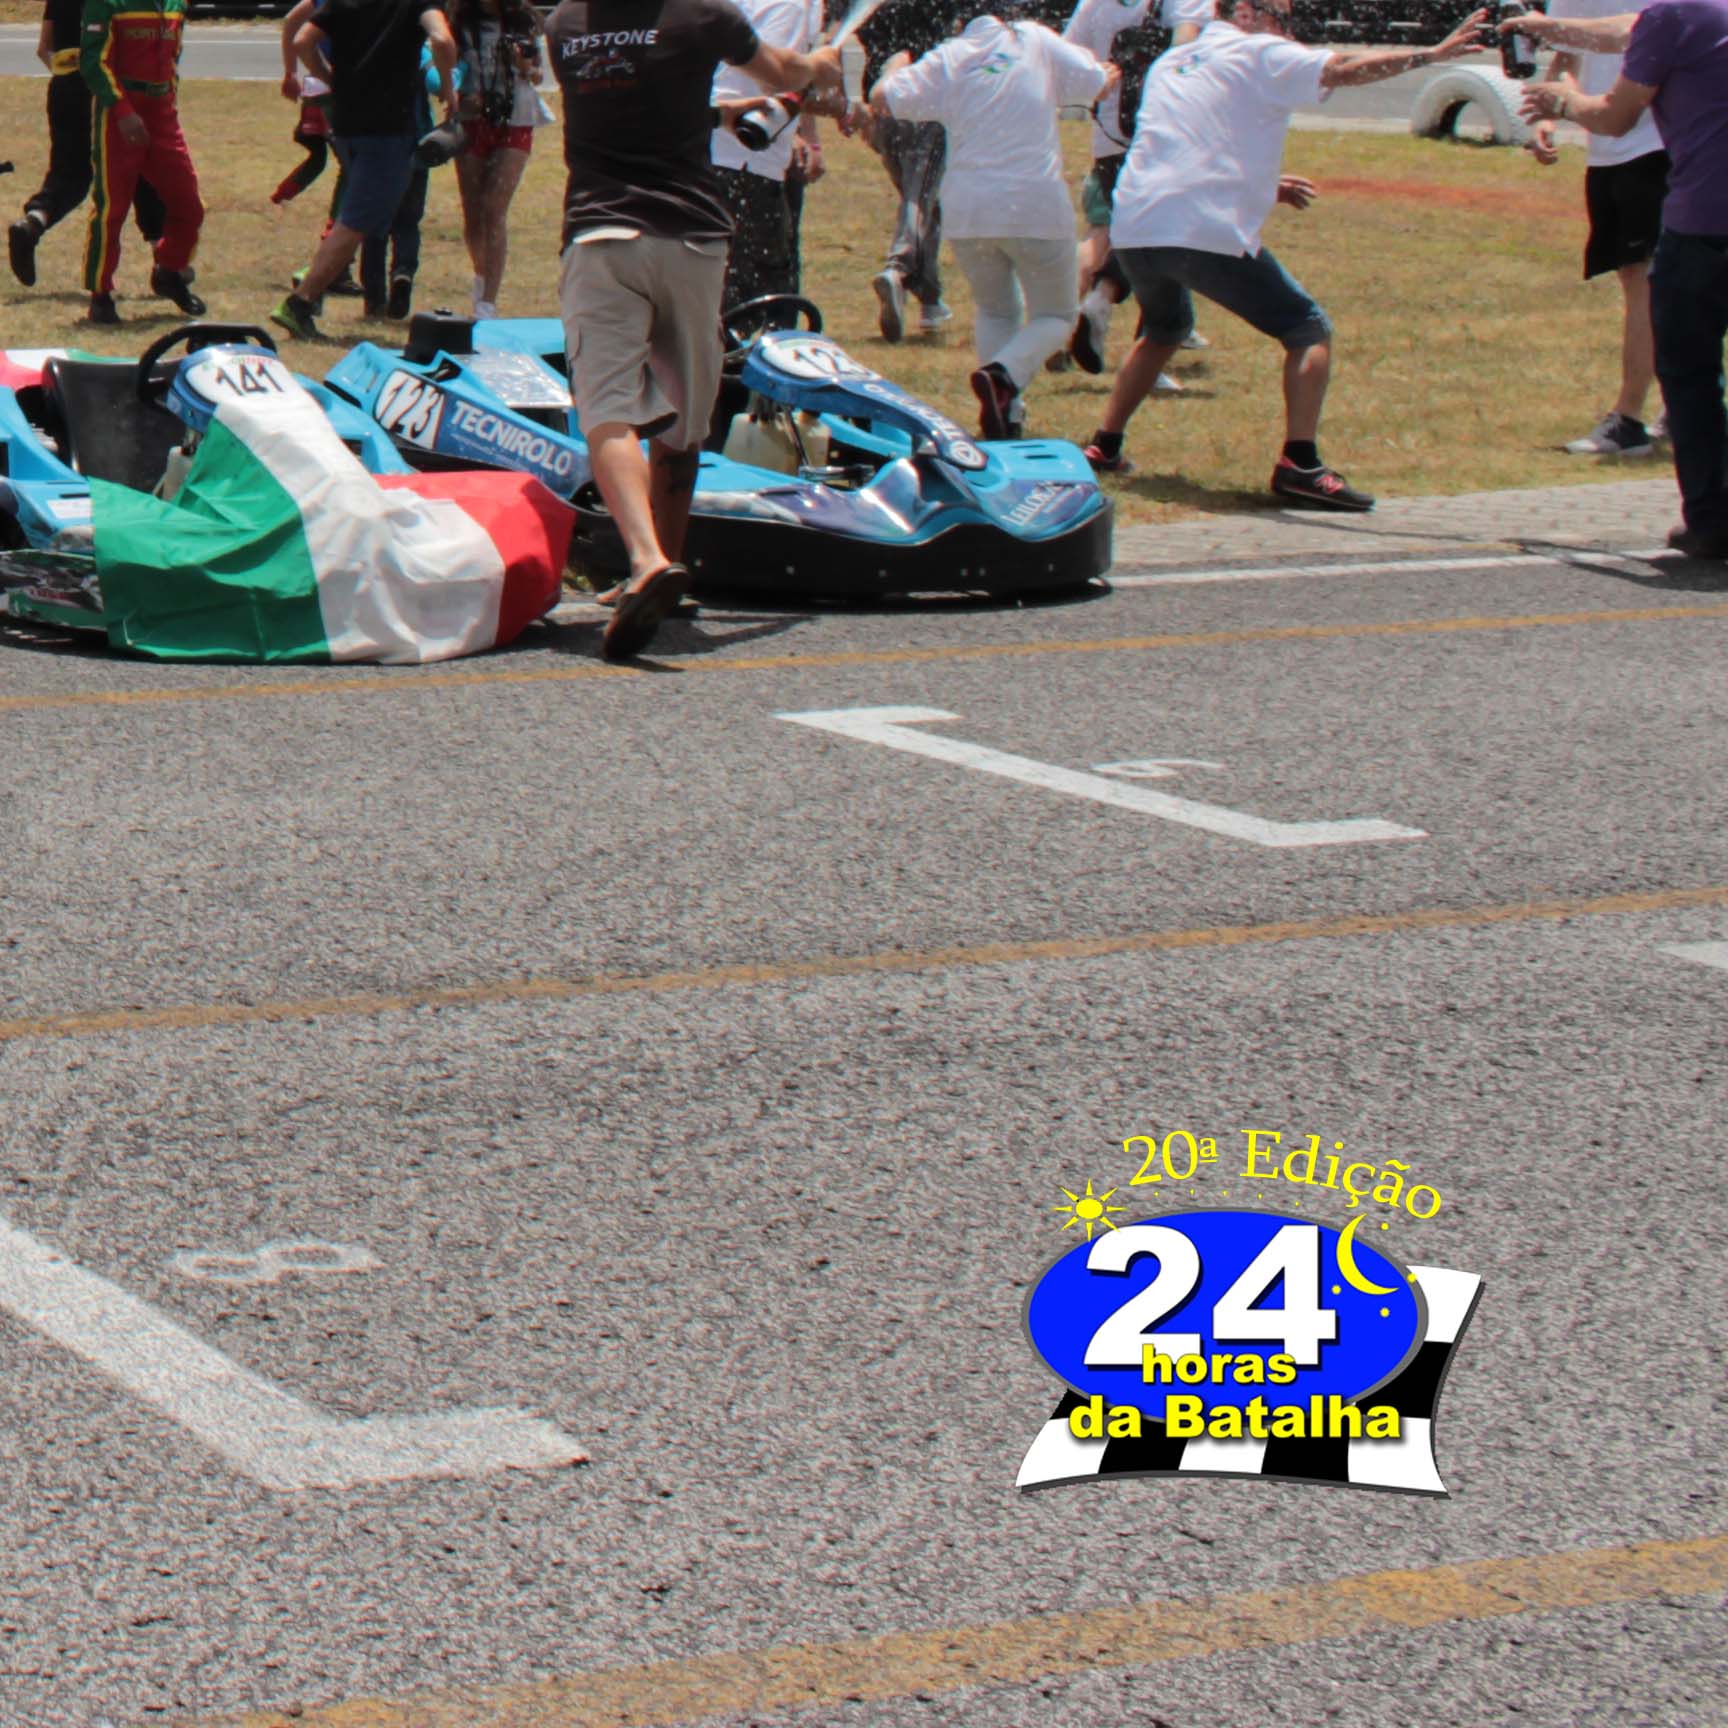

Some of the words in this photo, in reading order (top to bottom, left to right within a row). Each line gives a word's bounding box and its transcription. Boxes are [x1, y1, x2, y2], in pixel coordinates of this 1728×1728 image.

[561, 30, 659, 60] KEYSTONE
[215, 363, 285, 397] 141
[377, 376, 440, 440] 123
[451, 400, 574, 477] TECNIROLO
[170, 1240, 372, 1283] 8
